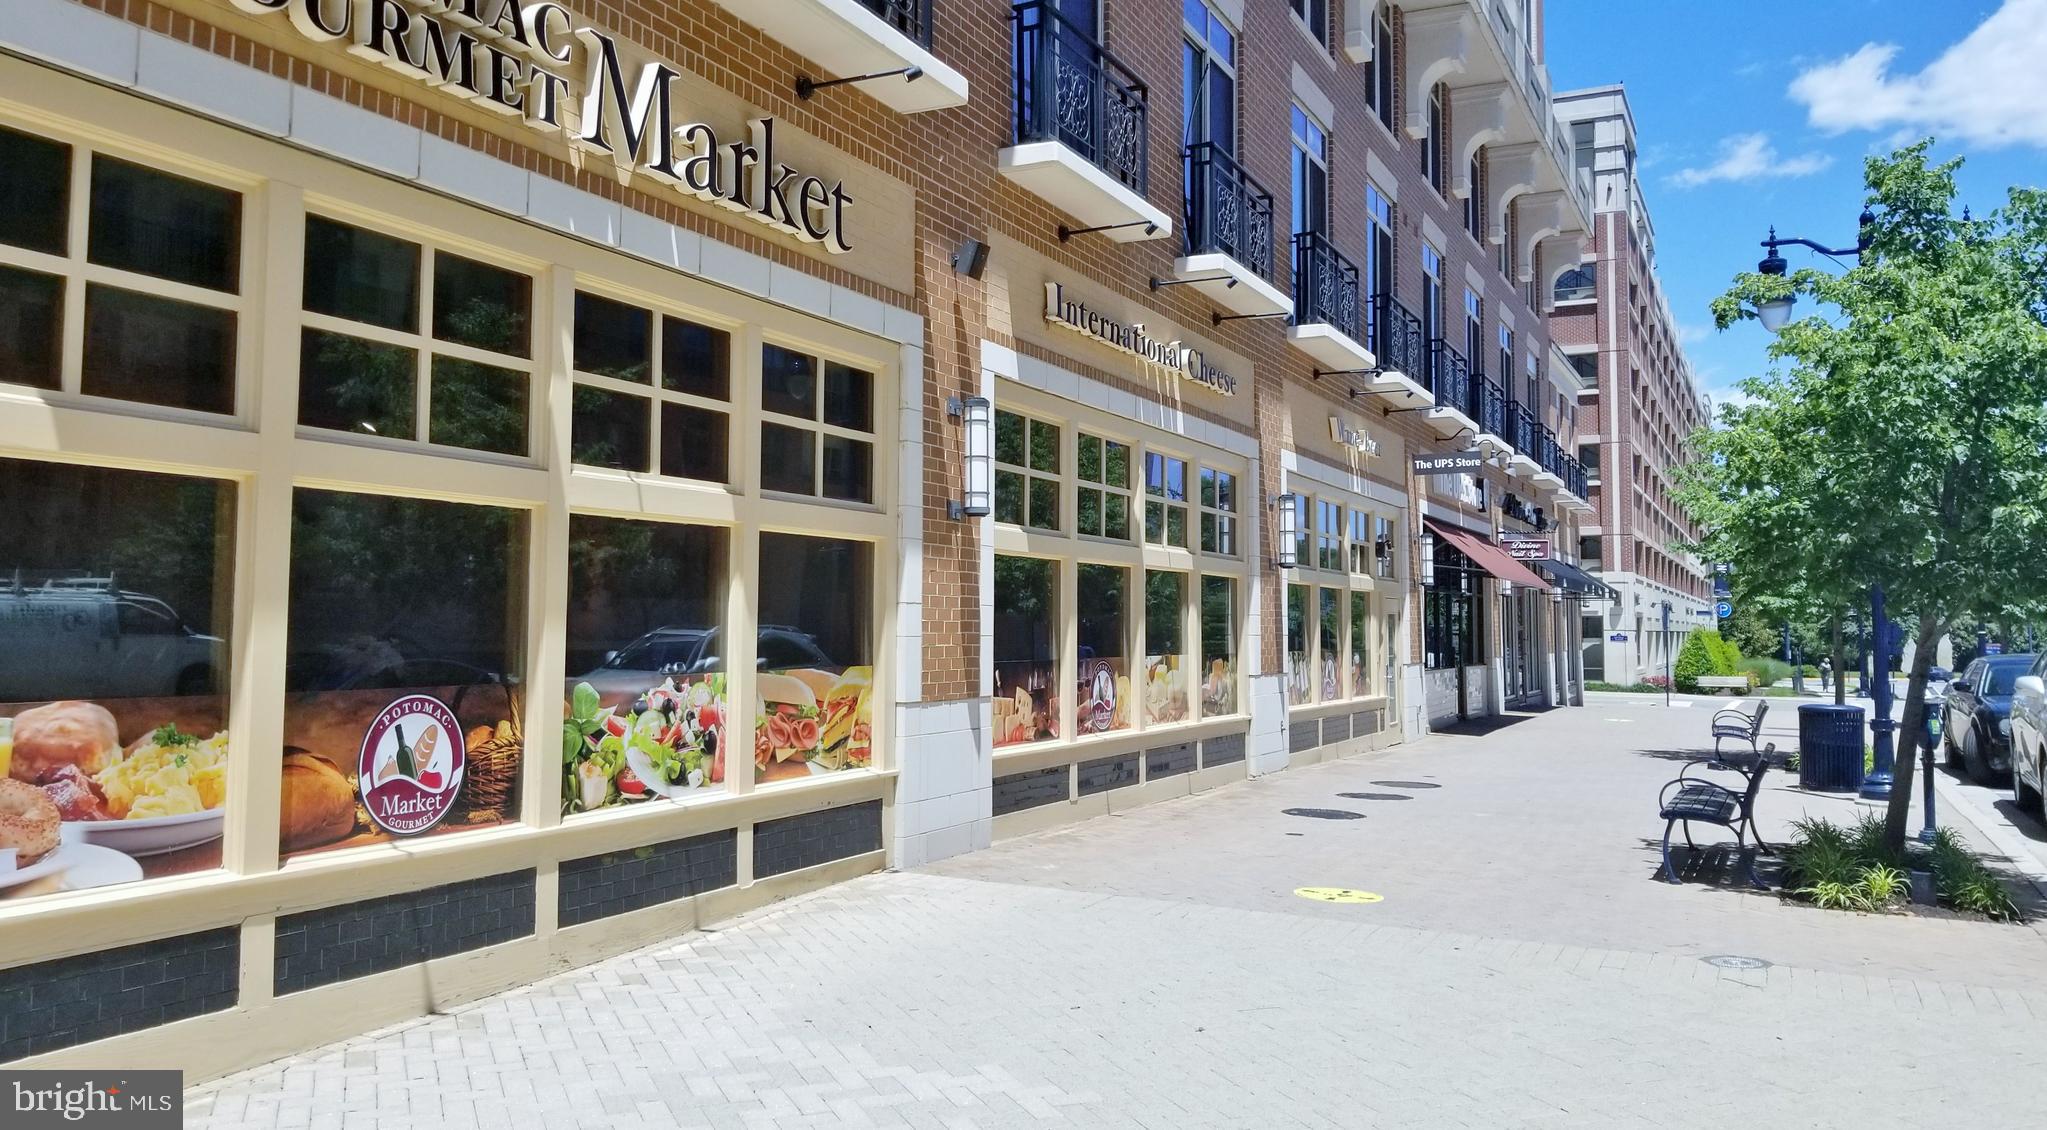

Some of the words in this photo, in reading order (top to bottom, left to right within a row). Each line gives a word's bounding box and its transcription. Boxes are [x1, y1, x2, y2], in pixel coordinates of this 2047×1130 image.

[247, 0, 570, 129] URMET
[586, 28, 853, 251] Market
[1051, 281, 1182, 371] International
[1187, 348, 1237, 396] Cheese
[1414, 460, 1432, 469] The
[1434, 458, 1454, 469] UPS
[1455, 457, 1481, 468] Store
[1511, 541, 1541, 549] Divine
[1527, 549, 1544, 559] Spa
[382, 701, 450, 726] POTOMAC
[380, 791, 443, 817] Market
[388, 811, 434, 829] GOURMET
